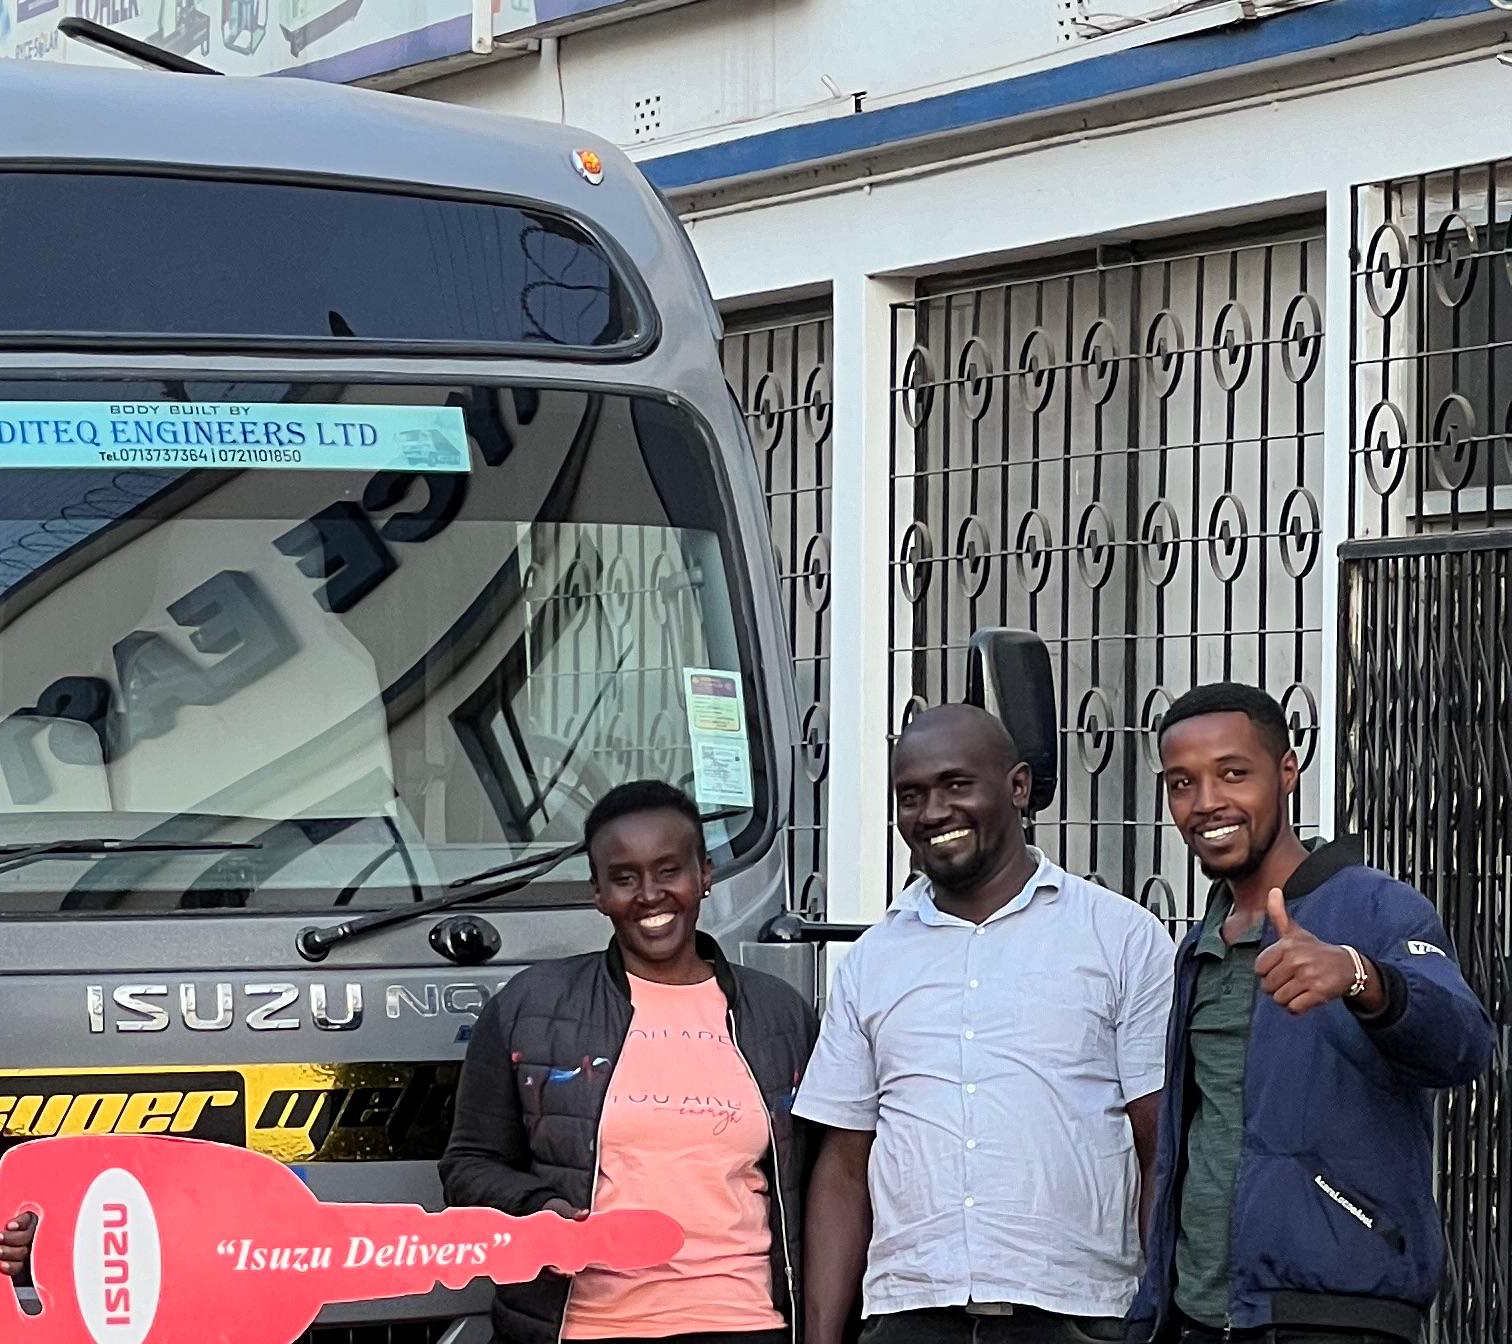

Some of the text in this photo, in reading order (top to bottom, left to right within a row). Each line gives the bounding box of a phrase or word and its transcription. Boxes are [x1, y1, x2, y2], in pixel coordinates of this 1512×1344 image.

[110, 404, 251, 416] BODY BUILT BY
[110, 420, 306, 447] ENGINEERS
[317, 421, 378, 446] LTD
[88, 982, 508, 1034] ISUZU NQ
[103, 1203, 130, 1325] ISUZU
